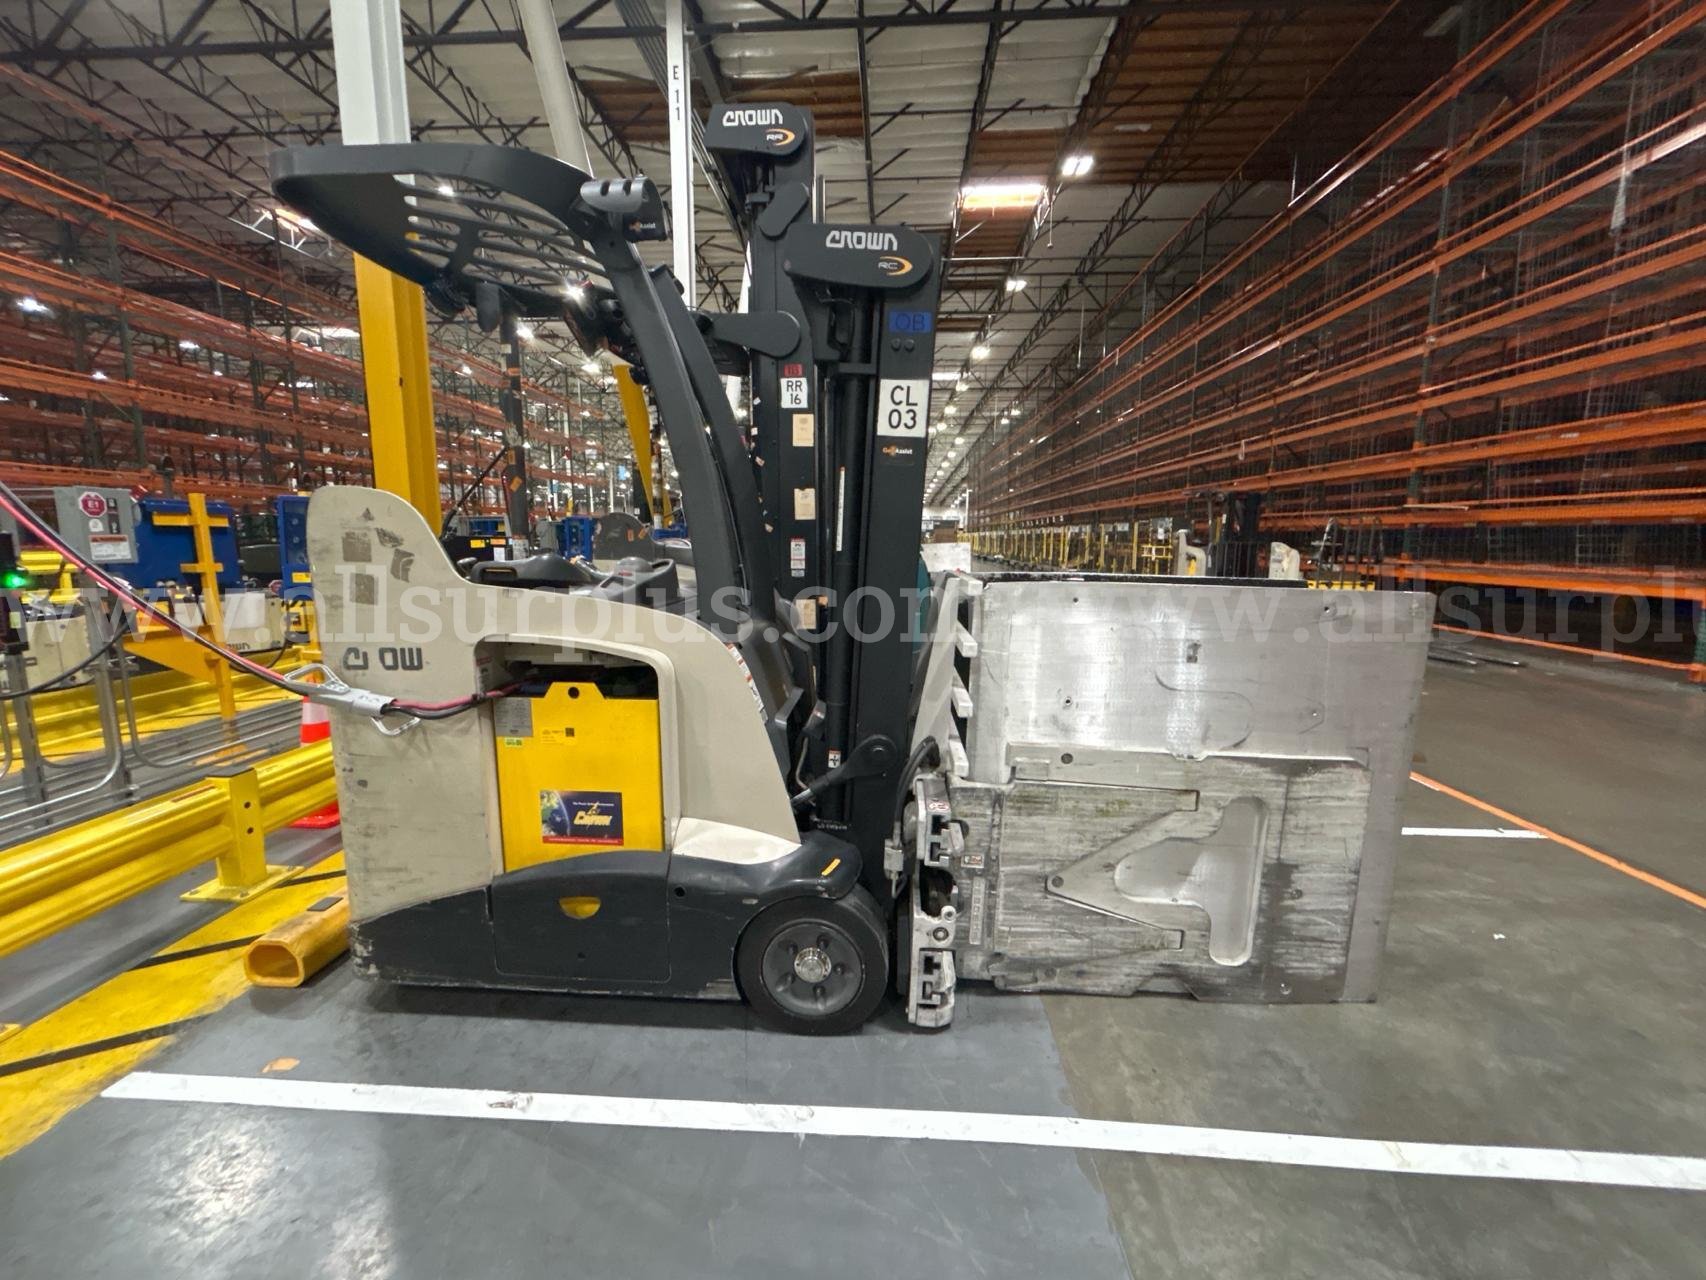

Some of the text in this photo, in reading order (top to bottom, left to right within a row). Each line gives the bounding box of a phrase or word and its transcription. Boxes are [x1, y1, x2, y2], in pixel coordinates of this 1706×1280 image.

[722, 109, 784, 127] CROWN
[825, 230, 898, 251] CROWN
[786, 380, 803, 392] RR
[890, 385, 918, 406] CL
[790, 393, 802, 405] 16
[888, 409, 917, 430] 03
